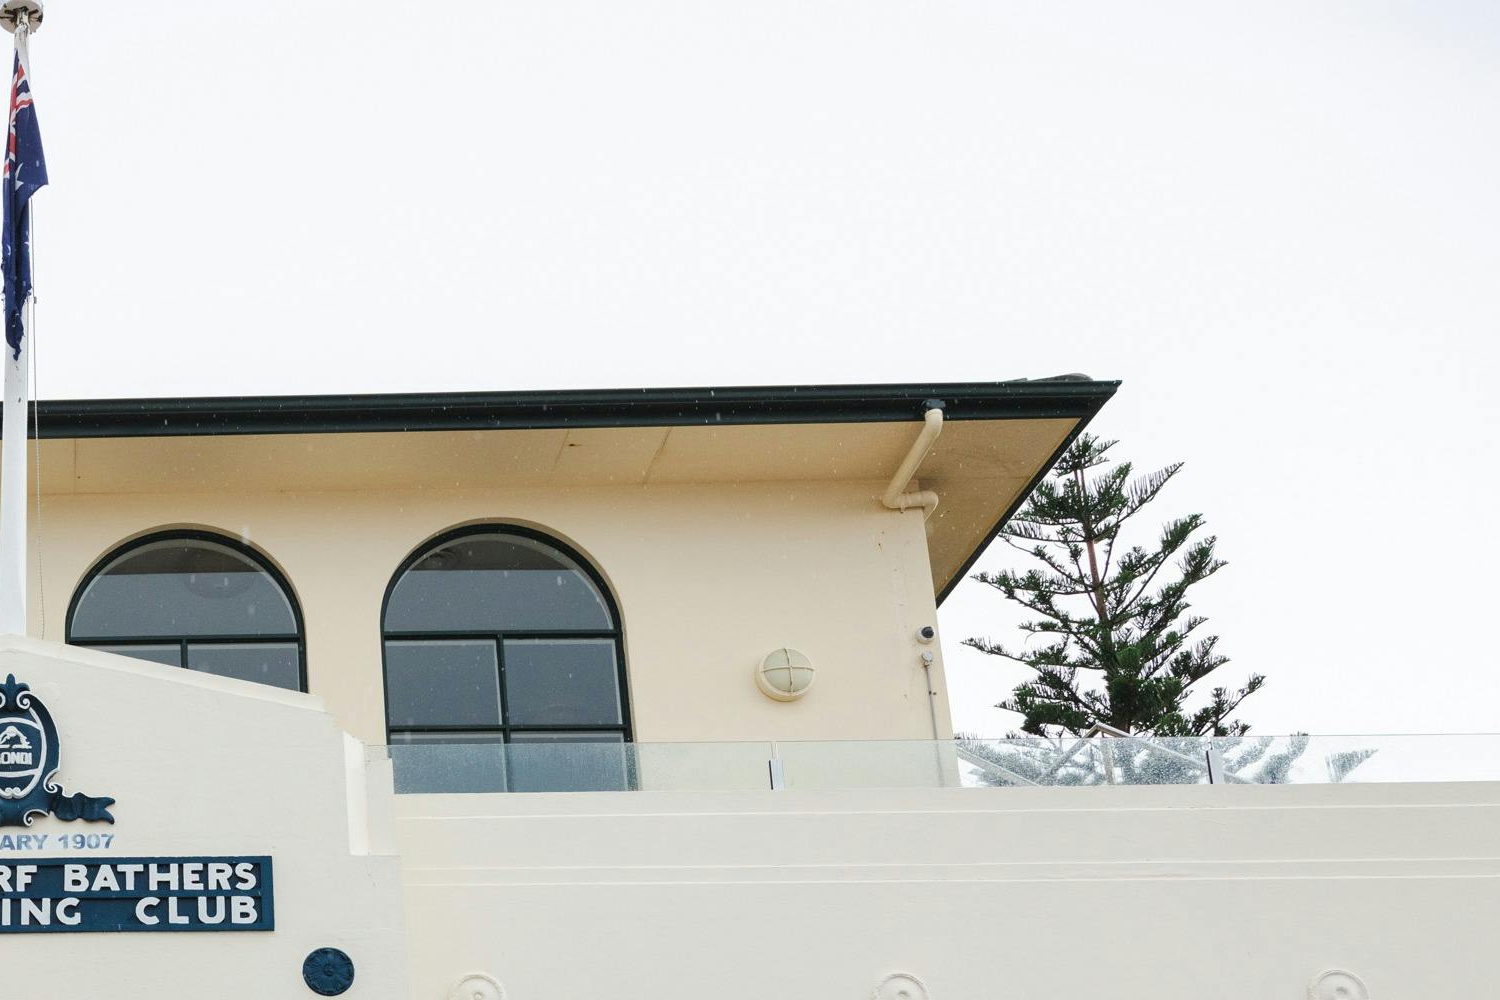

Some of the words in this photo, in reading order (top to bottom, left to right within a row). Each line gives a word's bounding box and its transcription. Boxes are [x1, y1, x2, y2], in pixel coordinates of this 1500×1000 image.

[57, 833, 115, 850] 1907
[63, 861, 258, 893] BATHERS
[135, 895, 258, 925] CLUB
